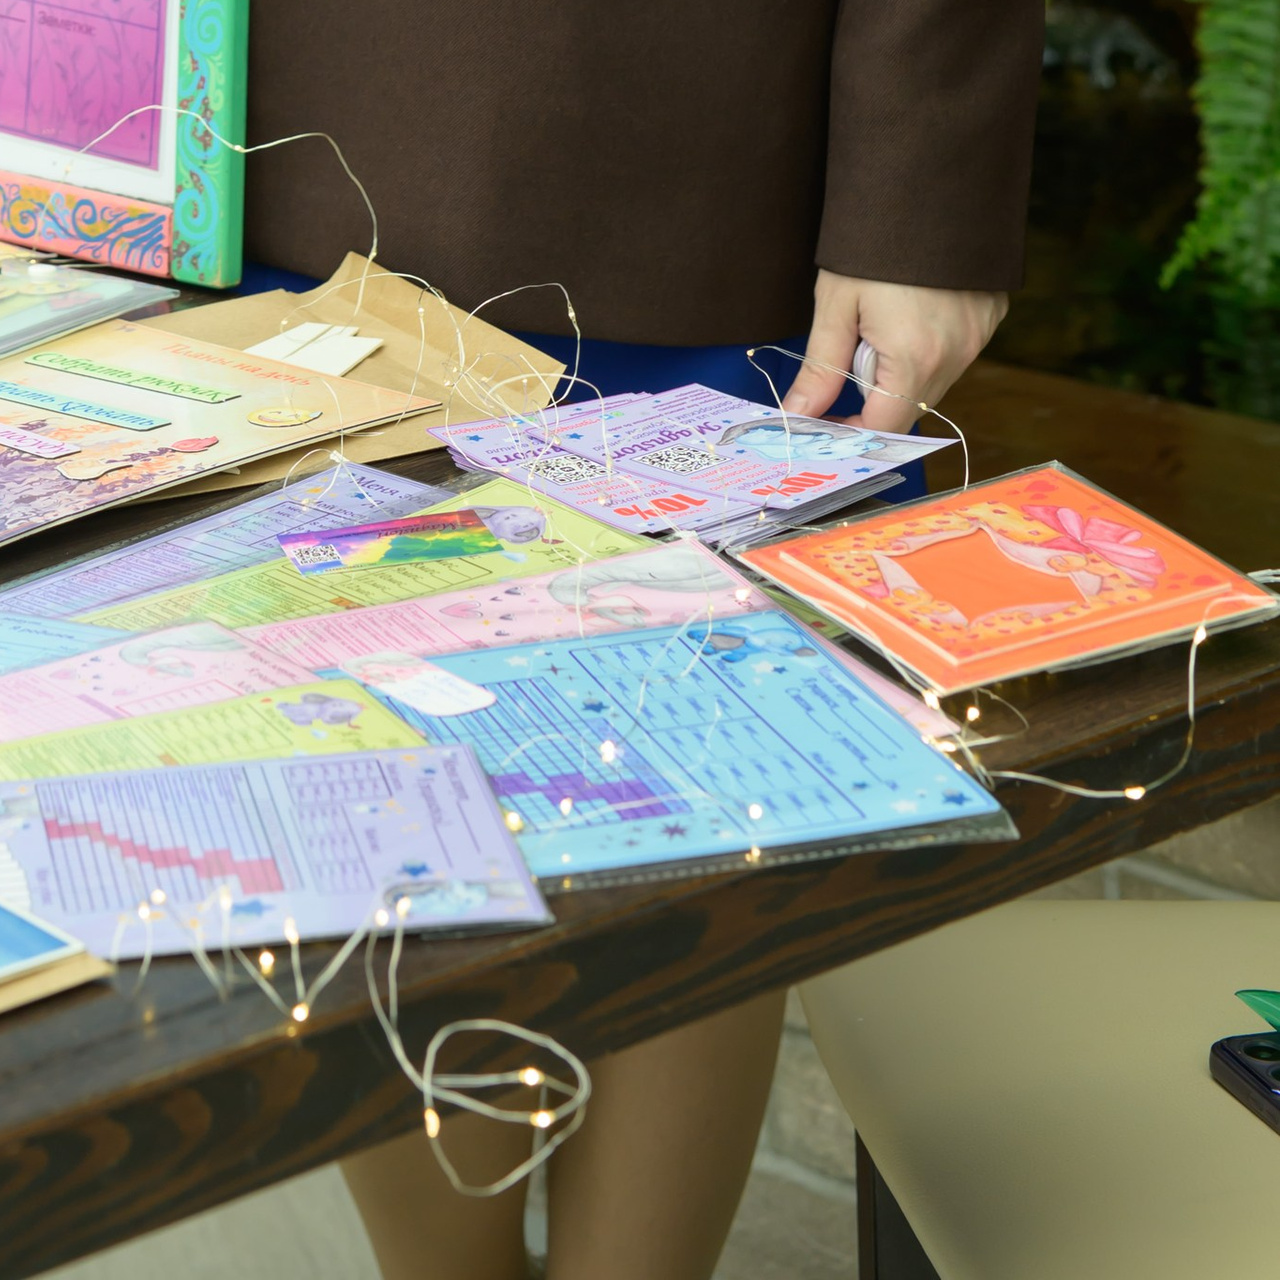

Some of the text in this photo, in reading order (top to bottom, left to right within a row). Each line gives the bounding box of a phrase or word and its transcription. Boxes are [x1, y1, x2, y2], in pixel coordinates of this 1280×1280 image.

[32, 352, 230, 401] Собрать рюкзак
[162, 343, 310, 387] Планы на день
[58, 399, 155, 427] кровать
[350, 474, 400, 497] Меня
[750, 471, 839, 497] 10%
[613, 493, 709, 520] 10%
